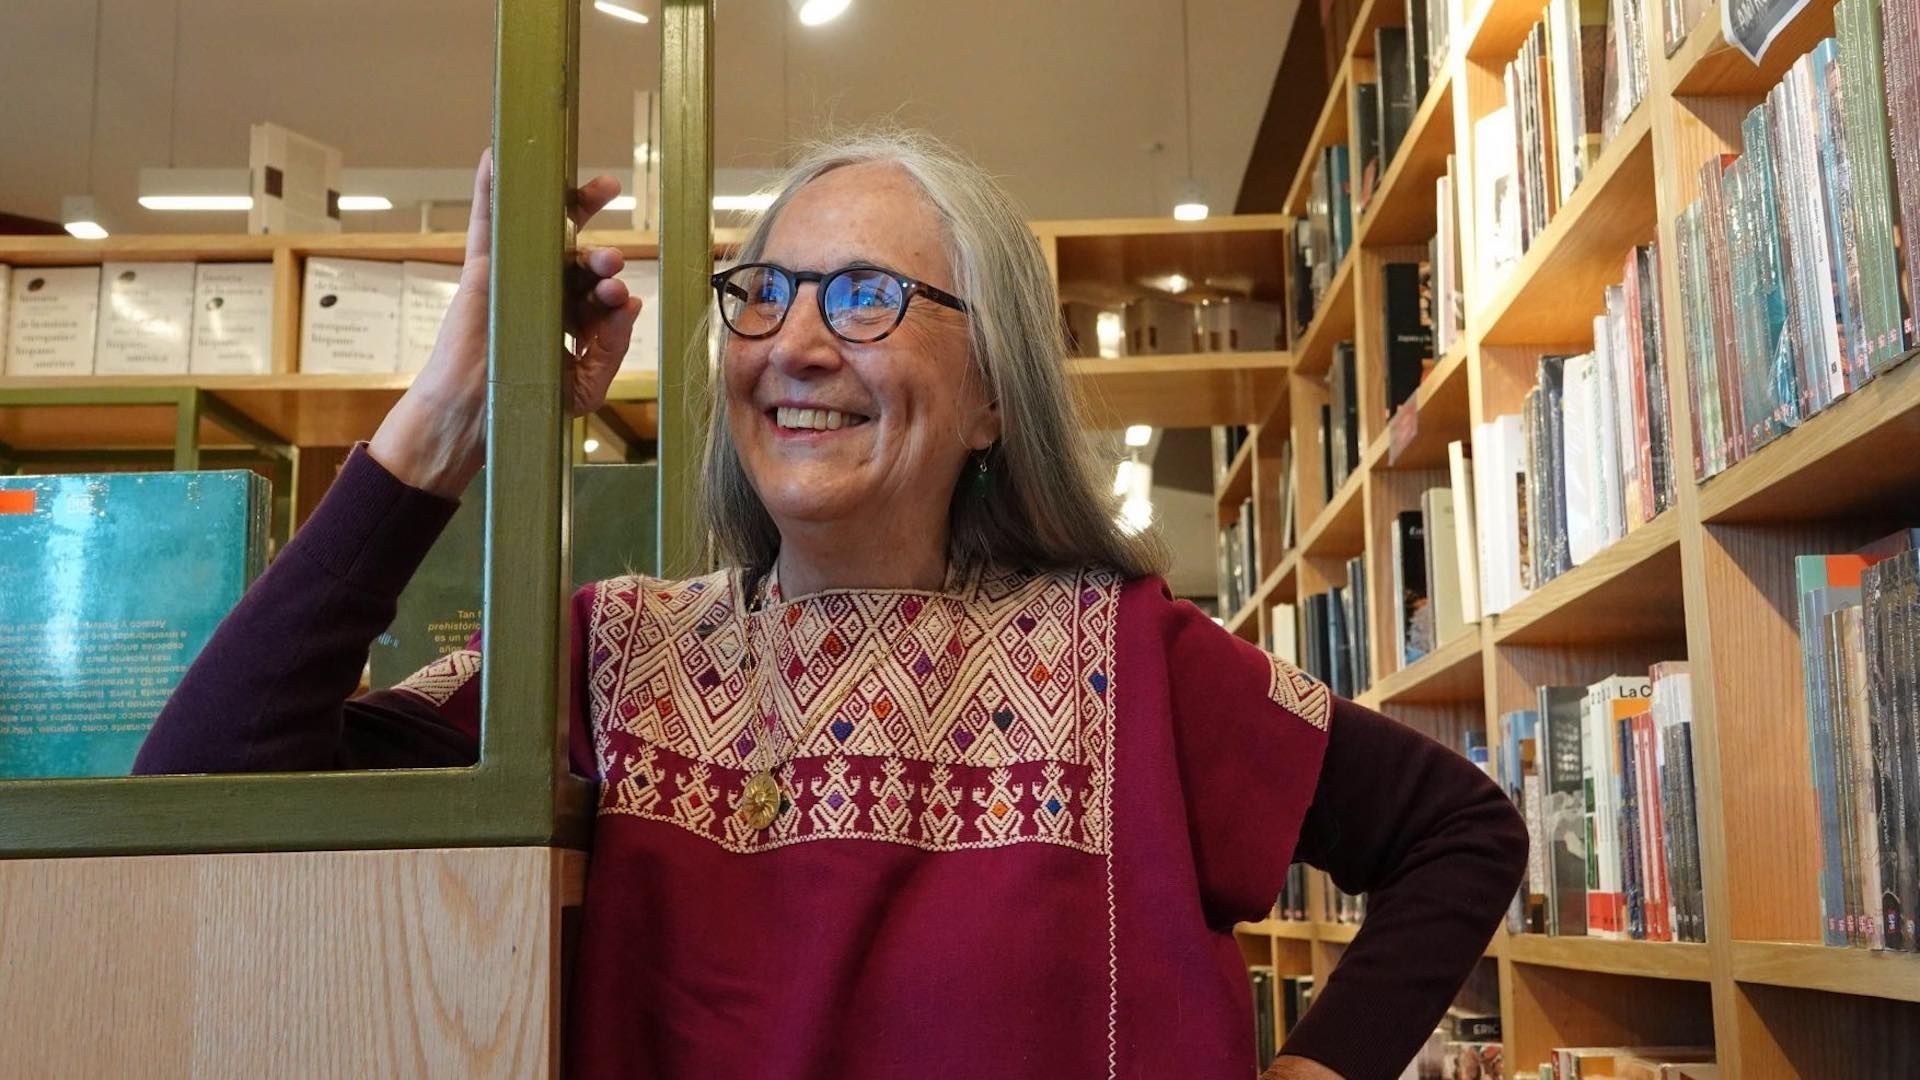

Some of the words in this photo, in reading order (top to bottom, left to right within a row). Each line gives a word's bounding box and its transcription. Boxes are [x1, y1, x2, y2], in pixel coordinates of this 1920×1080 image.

[458, 610, 475, 619] Tan
[427, 621, 481, 632] prehistóric
[1619, 685, 1637, 699] La
[1639, 685, 1652, 698] C
